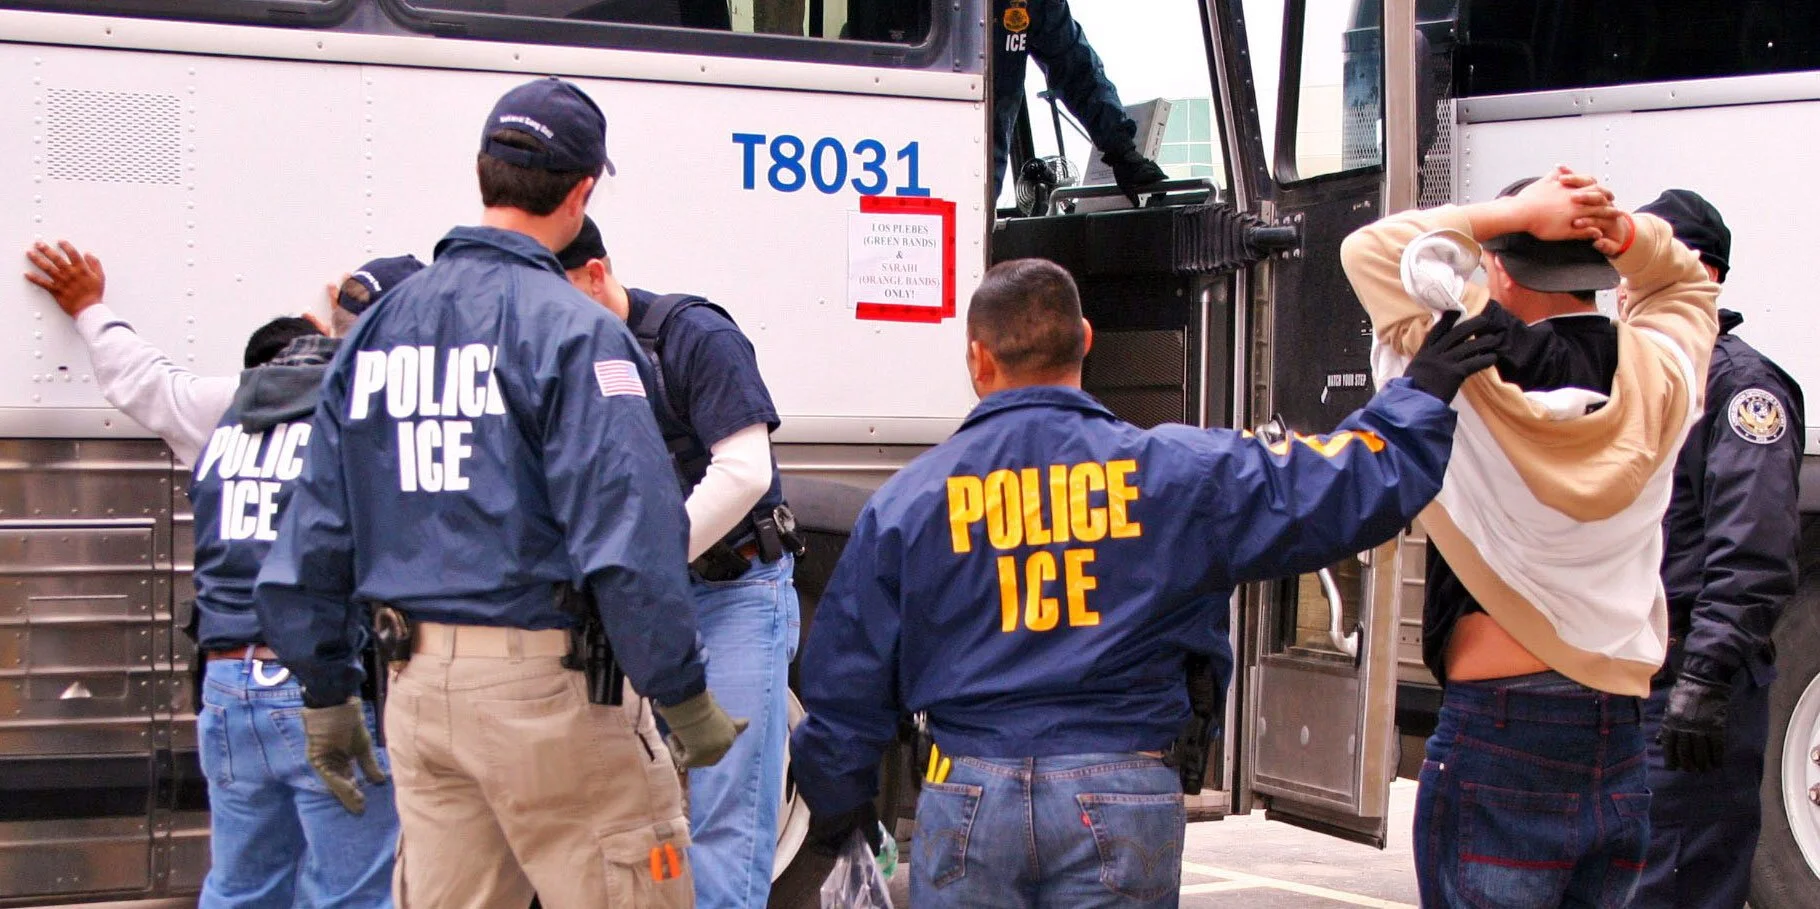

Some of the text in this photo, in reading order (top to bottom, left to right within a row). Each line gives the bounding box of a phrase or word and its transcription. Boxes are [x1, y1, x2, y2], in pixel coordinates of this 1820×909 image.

[1005, 34, 1027, 52] ICE
[731, 132, 931, 198] T8031
[871, 223, 929, 235] LOS PLEBES
[863, 235, 937, 249] (GREEN BANDS)
[895, 250, 903, 260] &
[858, 275, 941, 287] (ORANGE BANDS)
[884, 288, 915, 299] ONLY!
[1354, 373, 1367, 387] STEP
[196, 421, 313, 482] POLIC
[397, 418, 473, 493] ICE
[220, 479, 282, 541] ICE
[946, 458, 1142, 554] POLICE
[997, 548, 1101, 633] ICE
